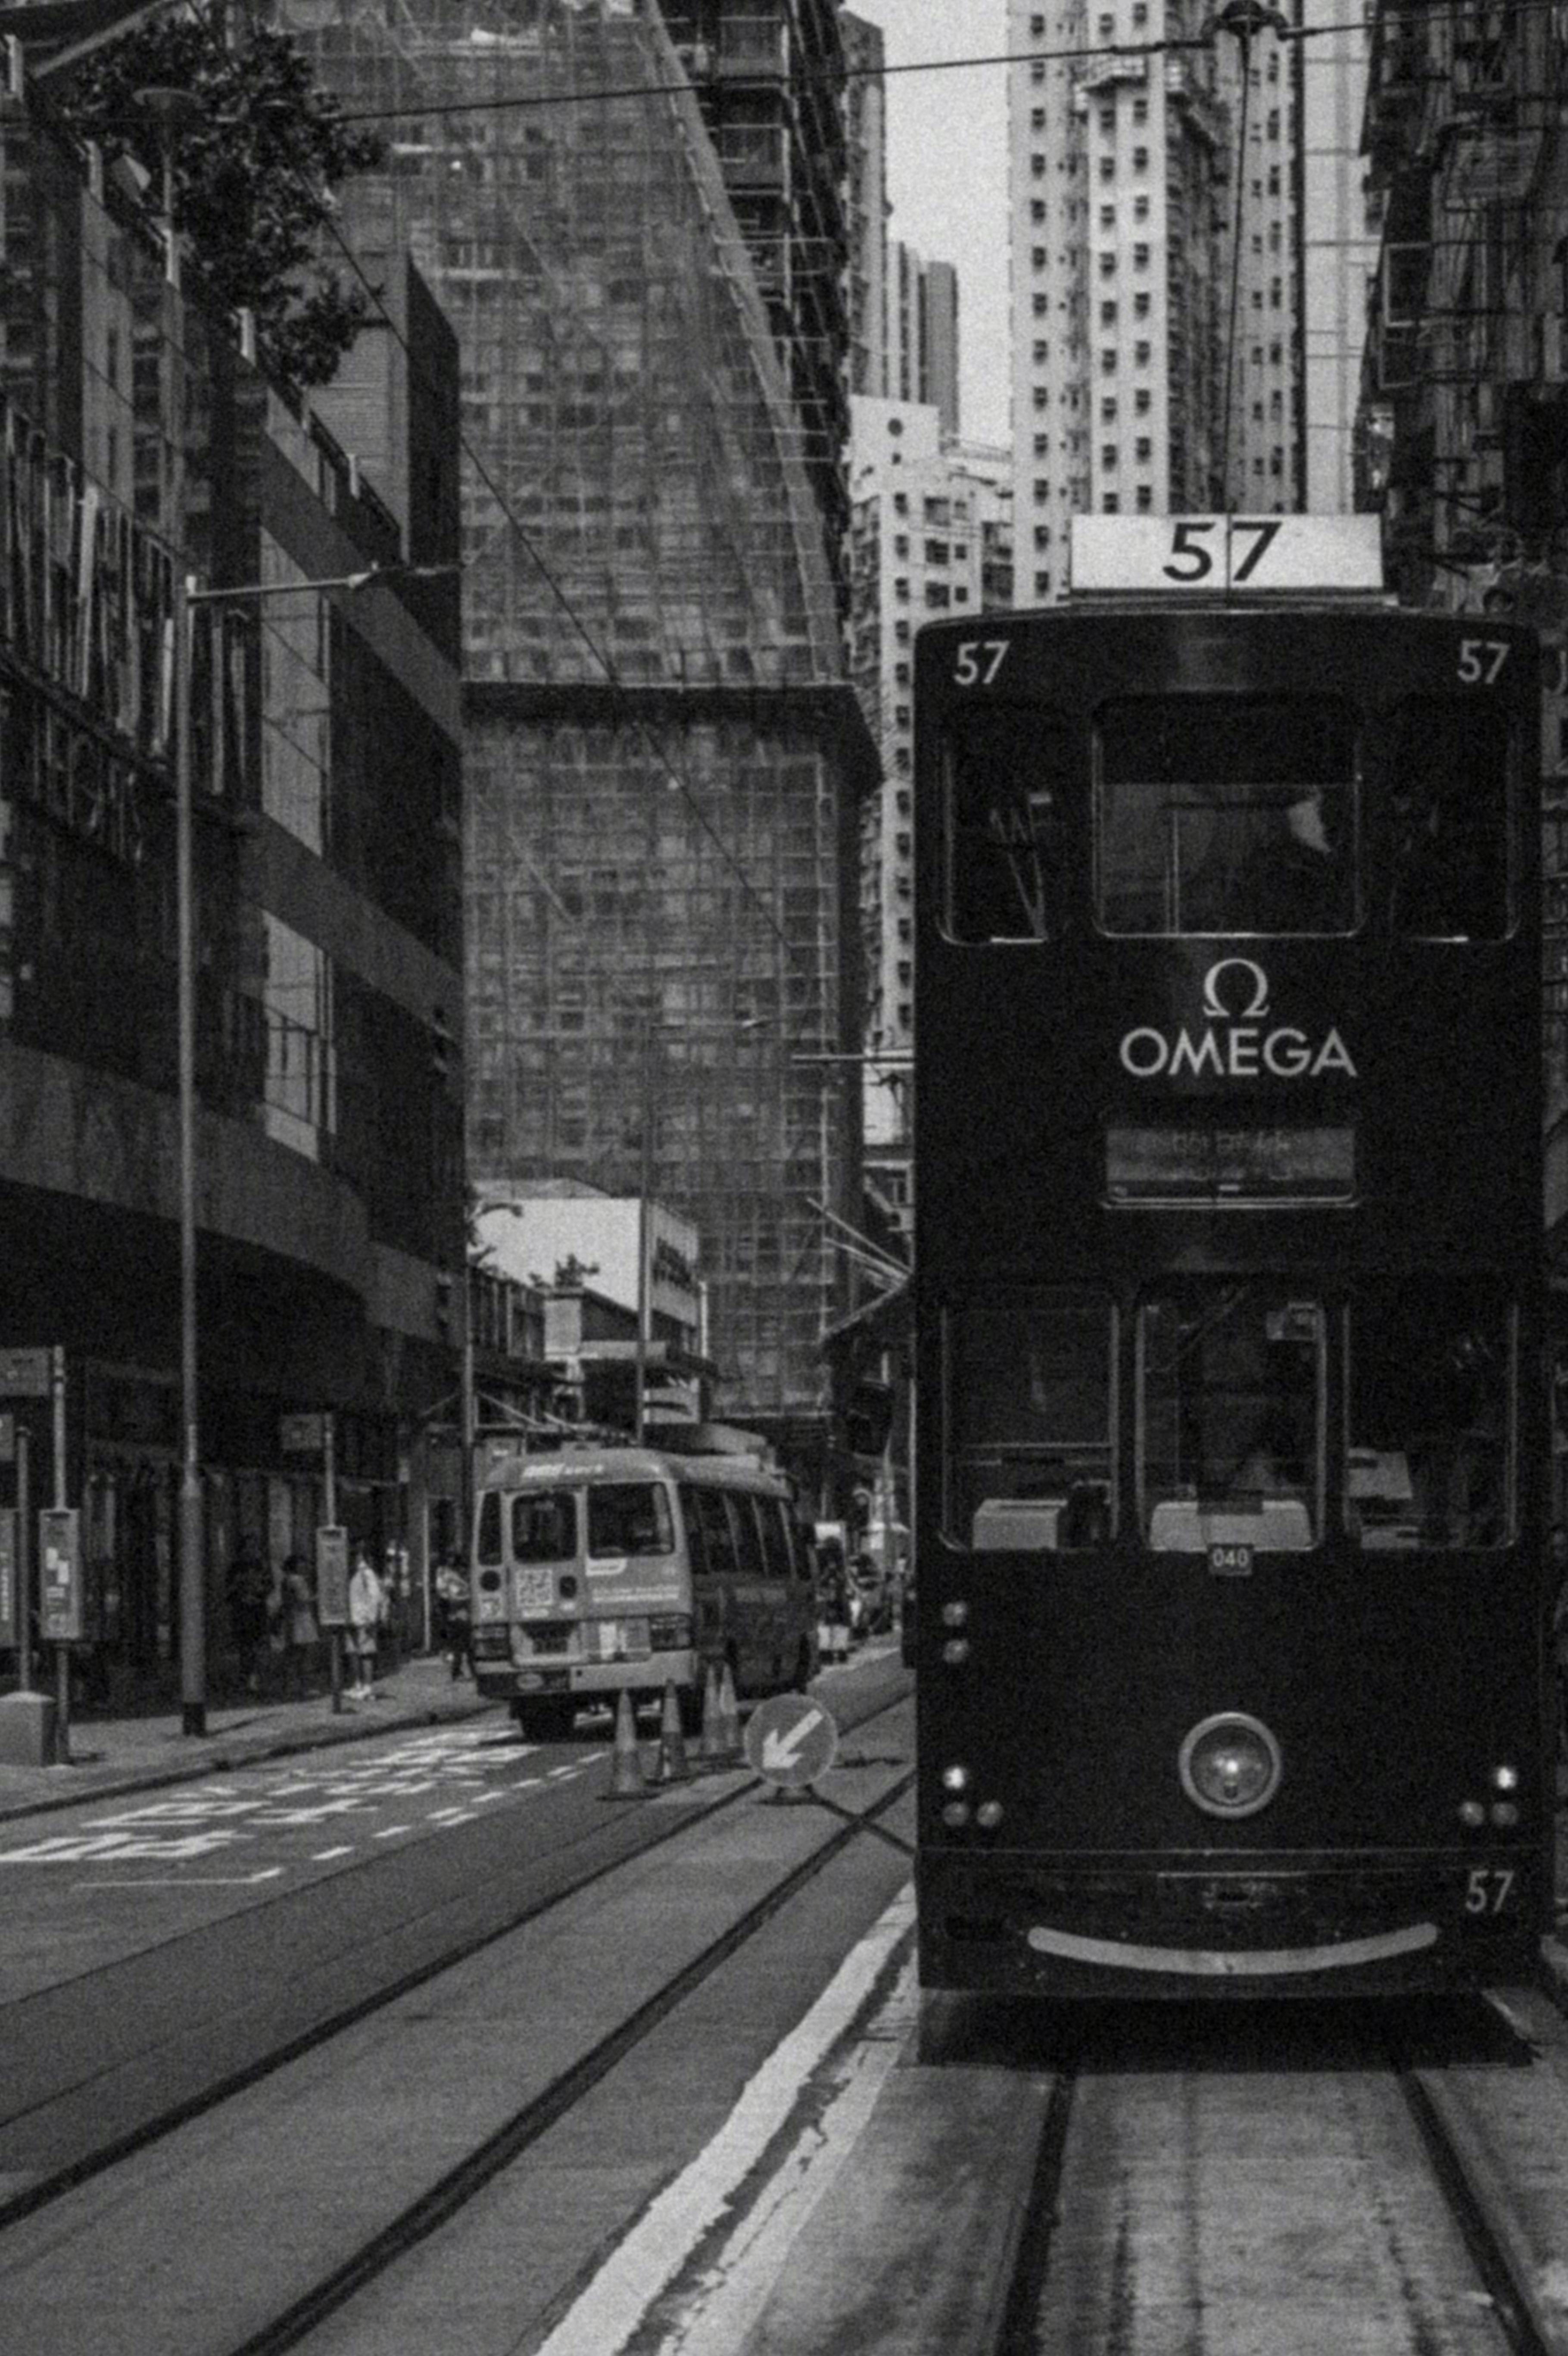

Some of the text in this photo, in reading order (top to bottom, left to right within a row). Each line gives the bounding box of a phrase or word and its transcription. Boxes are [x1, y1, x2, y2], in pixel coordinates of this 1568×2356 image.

[1163, 521, 1281, 581] 57
[954, 640, 1010, 685] 57
[1458, 640, 1511, 684] 57
[1120, 1027, 1357, 1077] OMEGA
[1212, 1548, 1249, 1568] 040
[1465, 1869, 1515, 1913] 57
